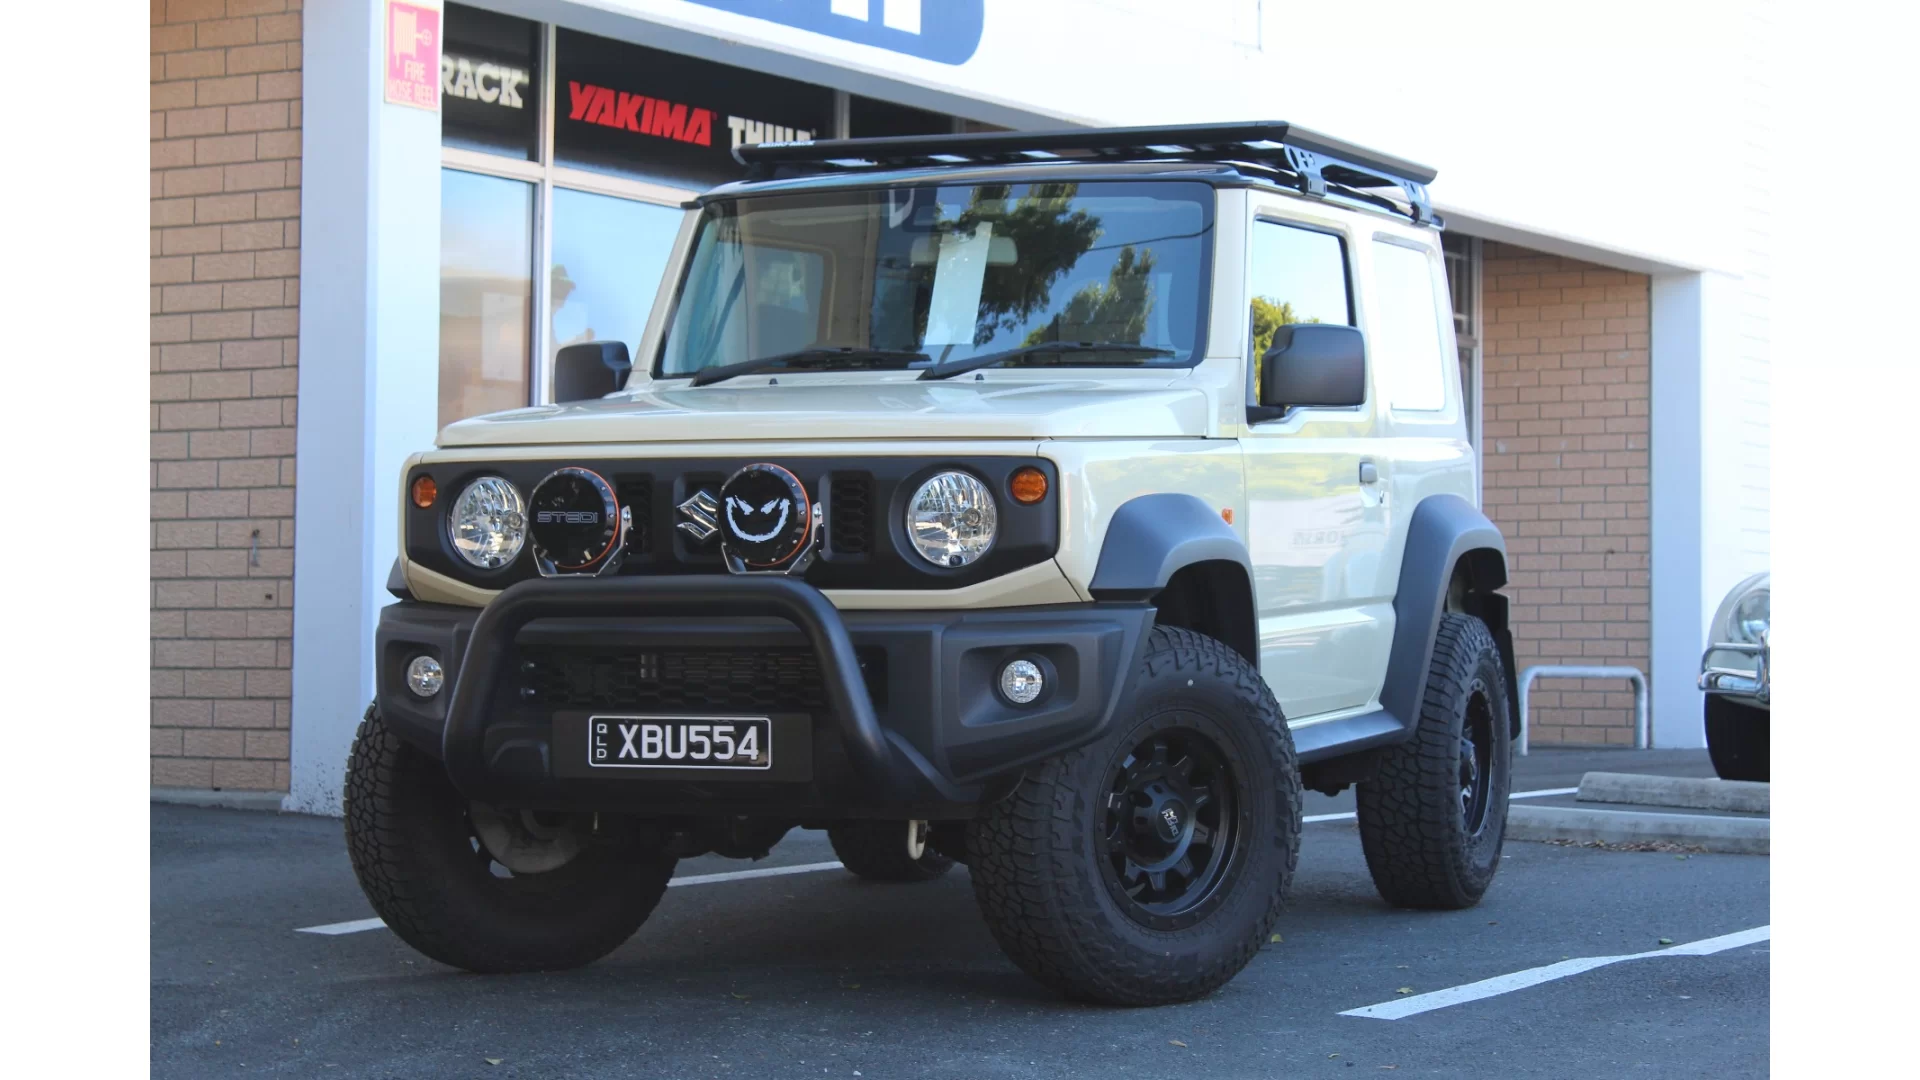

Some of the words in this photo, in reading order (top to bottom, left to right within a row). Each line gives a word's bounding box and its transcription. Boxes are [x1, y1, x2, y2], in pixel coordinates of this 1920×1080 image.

[404, 59, 425, 84] FIRE
[388, 79, 413, 102] HOSE
[568, 80, 712, 147] YAKIMA
[537, 511, 599, 524] STEDI
[596, 723, 608, 759] QLD
[618, 724, 760, 760] XBU554
